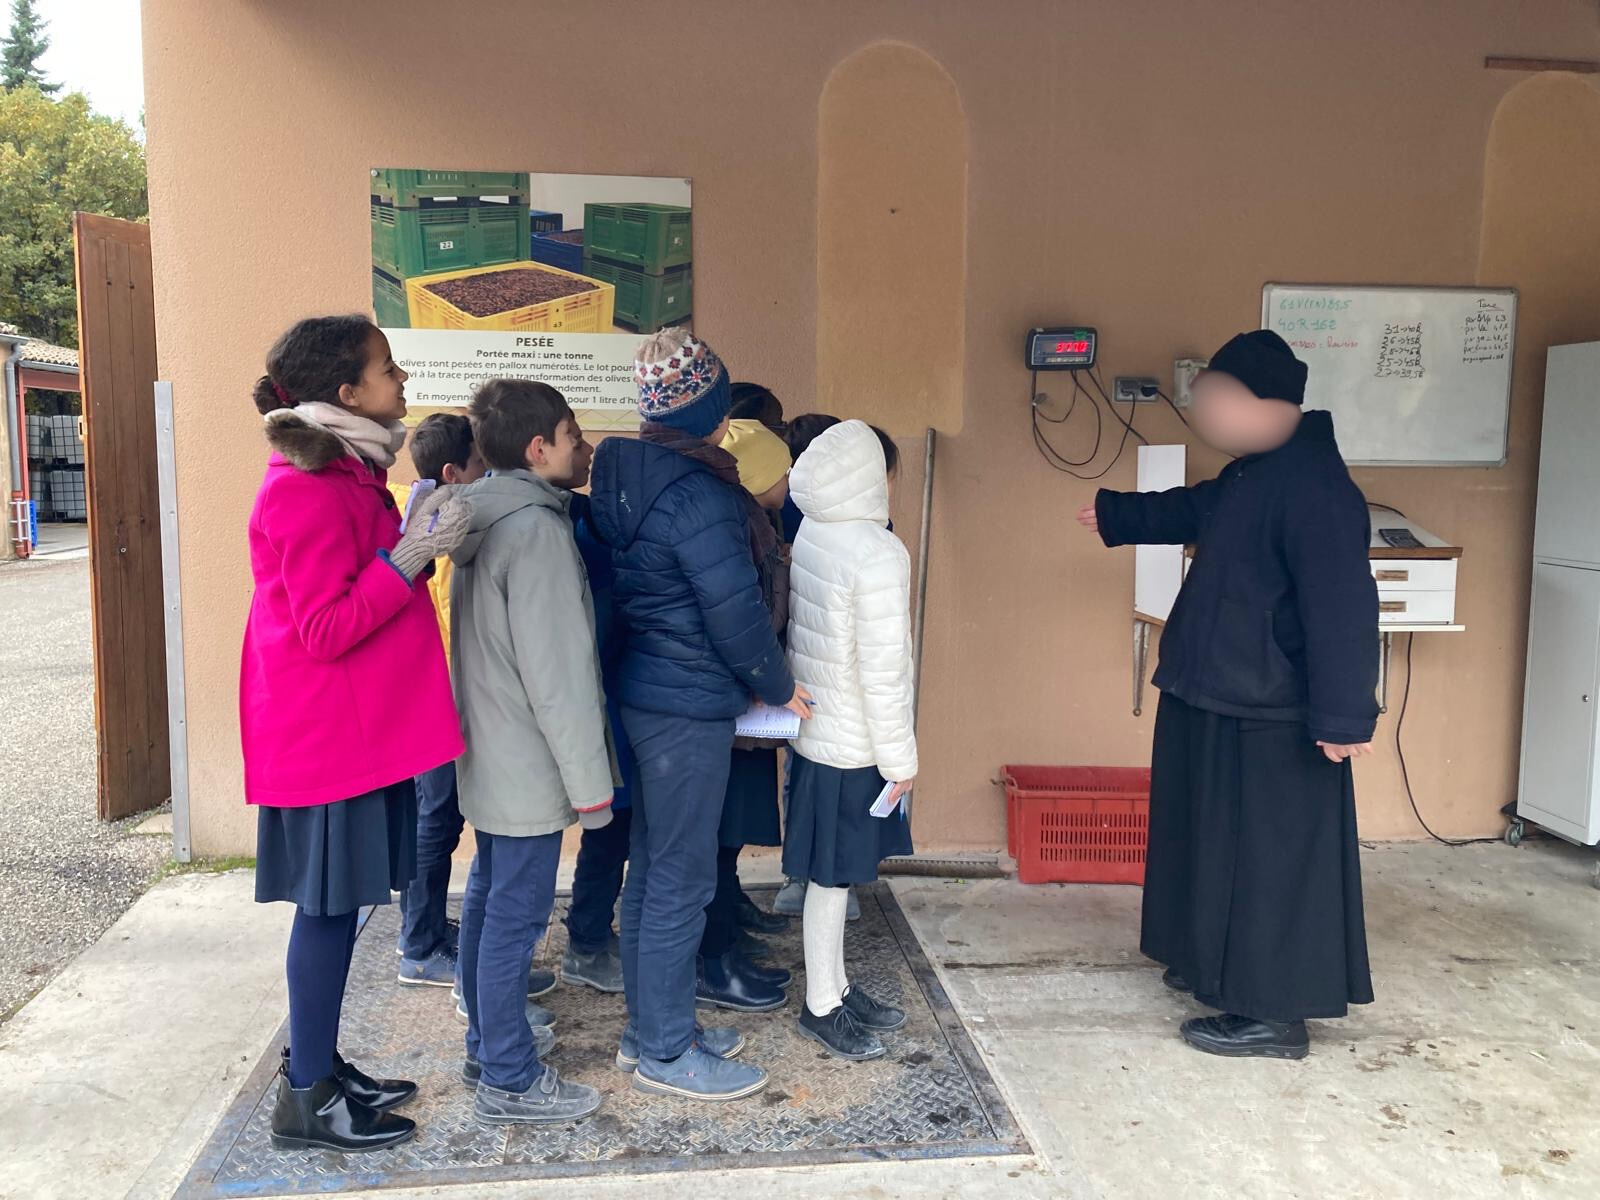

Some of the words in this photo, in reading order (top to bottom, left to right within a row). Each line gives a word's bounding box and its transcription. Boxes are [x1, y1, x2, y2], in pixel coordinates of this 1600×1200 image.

[515, 336, 555, 348] PESÉE
[476, 349, 510, 359] Portée
[511, 350, 536, 360] maxi
[543, 351, 562, 361] une
[564, 352, 594, 362] tonne
[399, 360, 426, 368] olives
[428, 361, 450, 369] sont
[451, 360, 483, 371] pesées
[484, 362, 498, 370] en
[499, 361, 528, 373] pallox
[529, 361, 582, 373] numérotés.
[583, 363, 595, 372] Le
[596, 363, 609, 372] lot
[427, 371, 437, 379] la
[438, 371, 463, 380] trace
[587, 374, 603, 383] des
[604, 375, 632, 384] olives
[416, 392, 430, 401] En
[567, 396, 590, 405] pour
[599, 396, 618, 404] litre
